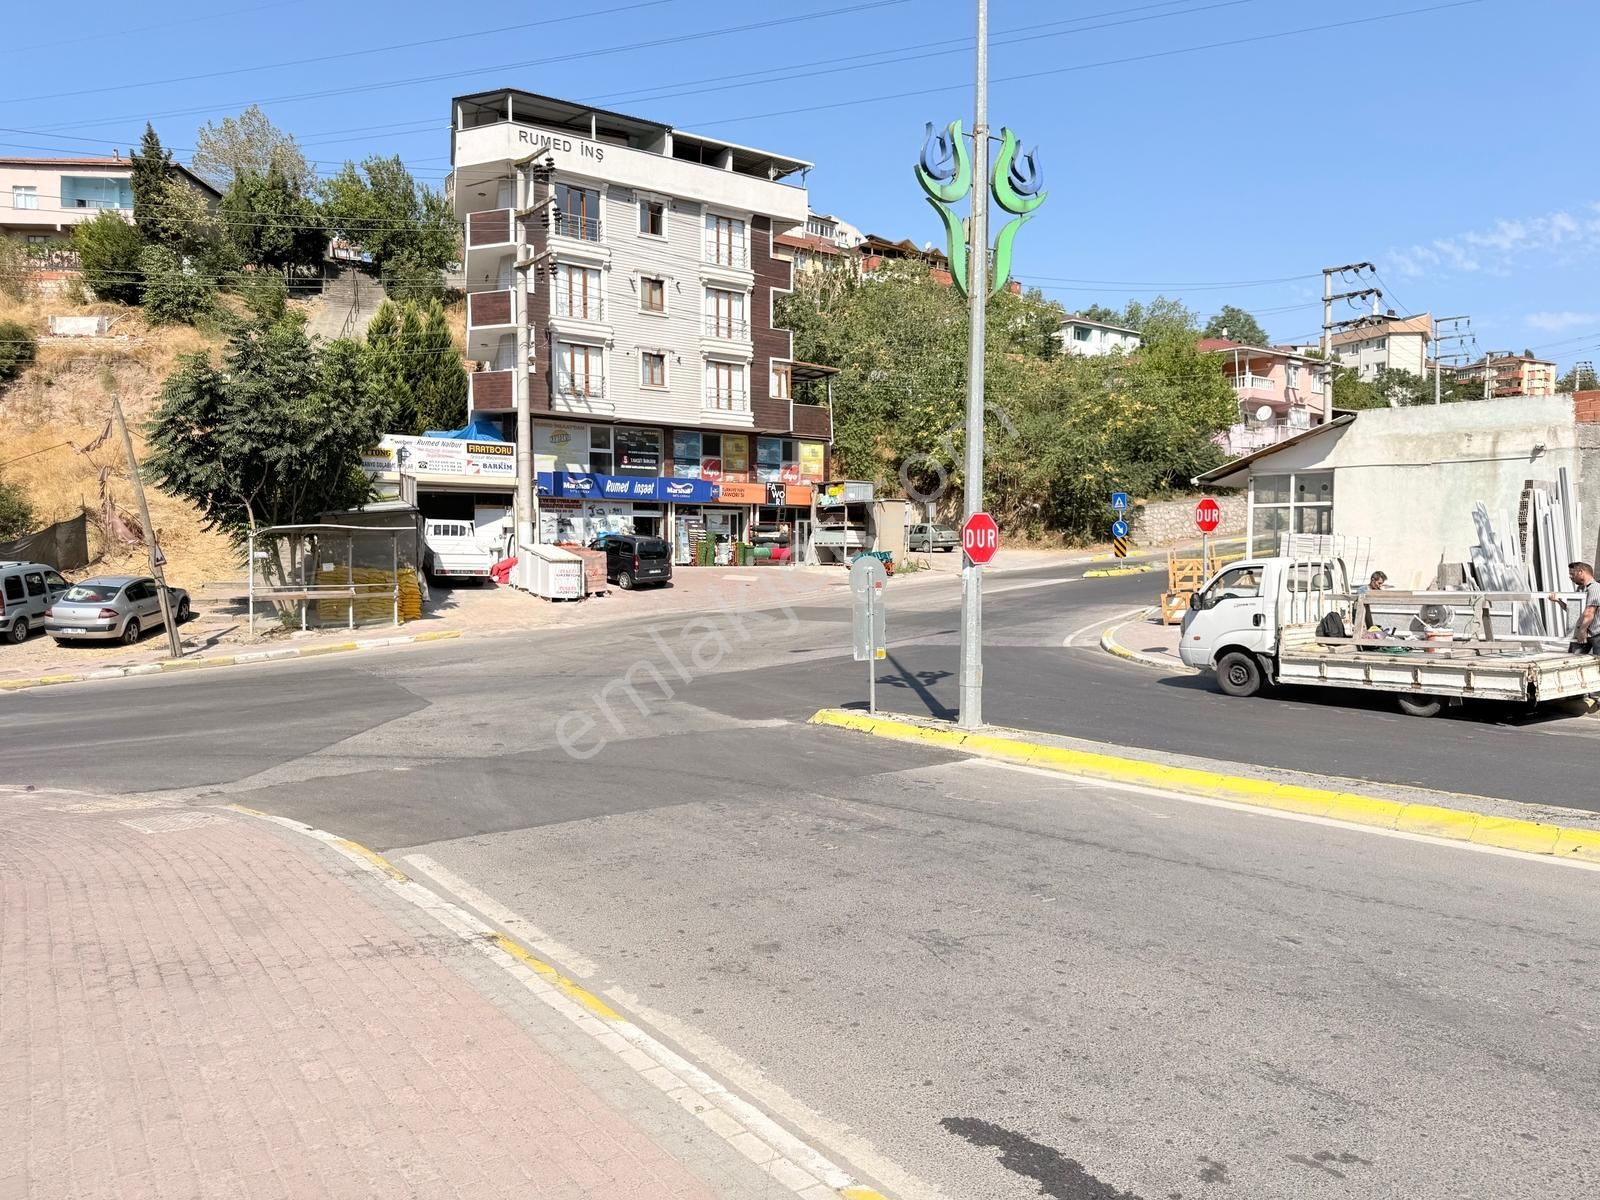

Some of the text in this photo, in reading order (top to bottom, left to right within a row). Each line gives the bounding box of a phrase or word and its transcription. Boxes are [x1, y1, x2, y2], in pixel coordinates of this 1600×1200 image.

[518, 130, 604, 163] RUMED İNŞ
[416, 438, 462, 449] Rumed Nalbur
[366, 448, 391, 458] TONG
[783, 471, 798, 481] dyo
[605, 479, 630, 494] Rumed
[666, 486, 692, 495] Marshall
[767, 482, 777, 490] FA
[772, 490, 785, 499] WO
[1195, 507, 1220, 524] DUR
[965, 528, 998, 550] DUR
